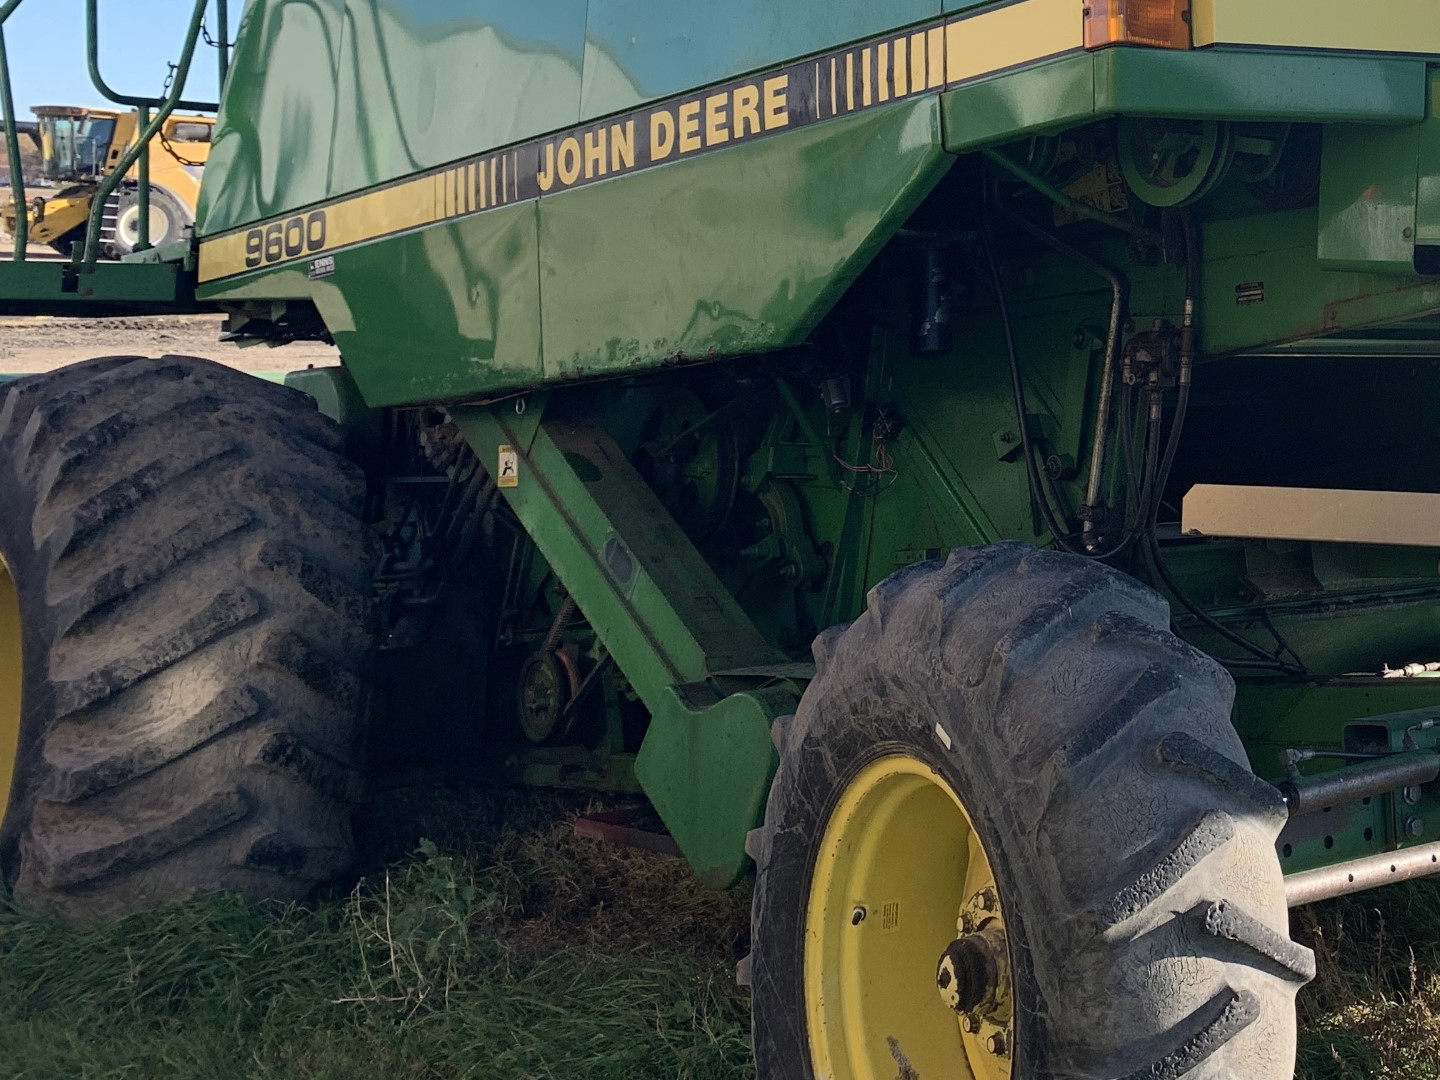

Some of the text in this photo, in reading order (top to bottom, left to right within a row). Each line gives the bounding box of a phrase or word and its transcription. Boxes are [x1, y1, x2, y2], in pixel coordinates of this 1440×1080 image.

[536, 74, 789, 191] JOHN DEERE
[245, 210, 327, 268] 9600
